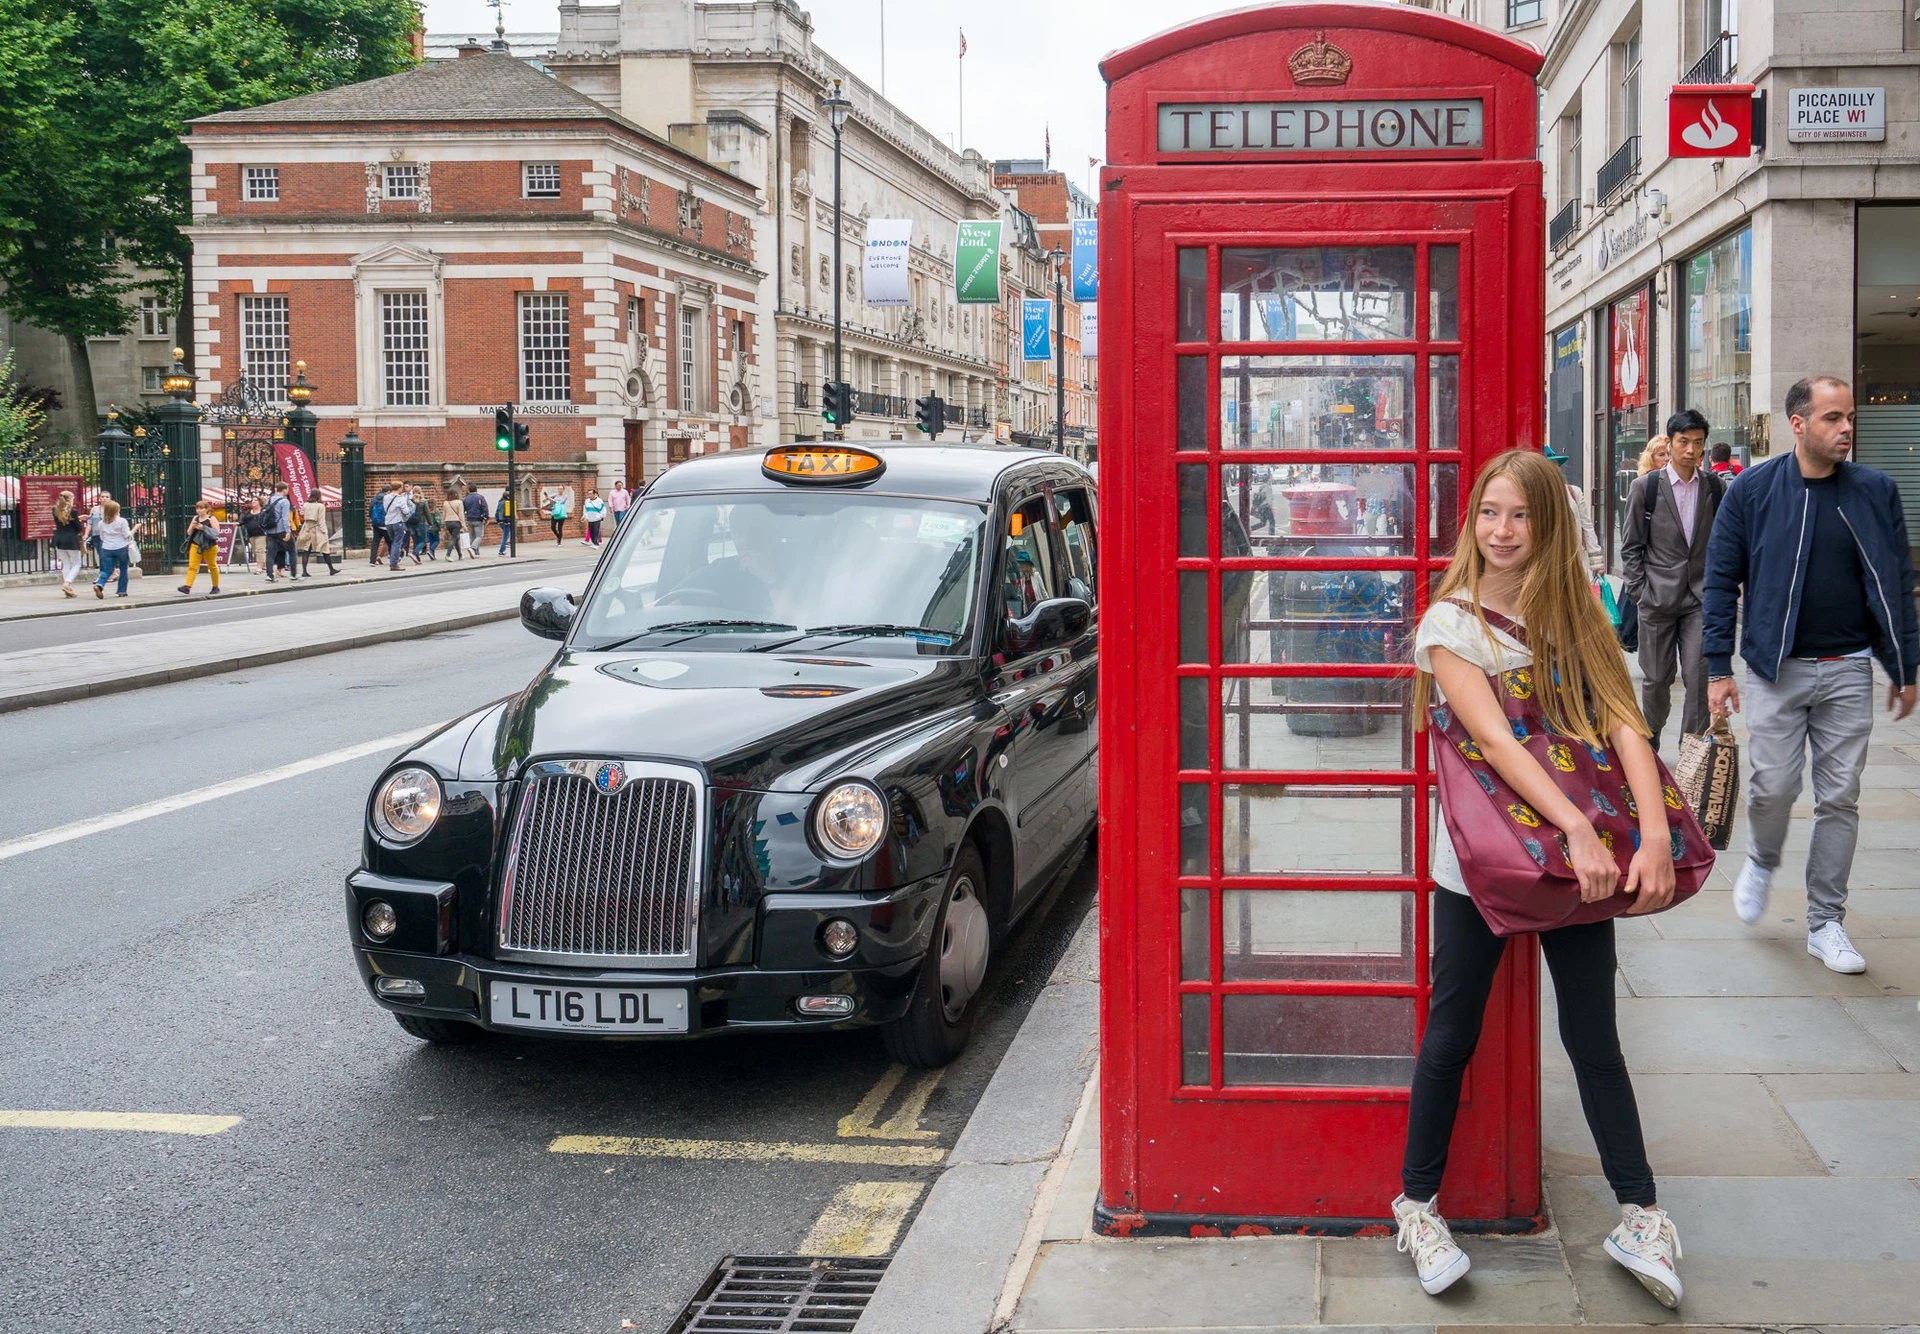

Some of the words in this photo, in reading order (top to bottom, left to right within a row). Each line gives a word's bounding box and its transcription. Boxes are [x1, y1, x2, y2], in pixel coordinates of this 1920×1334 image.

[1798, 93, 1876, 107] PICCADILLY
[1798, 110, 1840, 124] PLACE
[1847, 109, 1866, 123] W1
[1169, 108, 1471, 149] TELEPHONE
[962, 229, 991, 238] West
[1077, 227, 1096, 237] We
[866, 240, 908, 248] LONDON
[960, 237, 988, 247] End.
[1025, 305, 1045, 313] West
[479, 406, 519, 415] MAIN
[522, 405, 580, 415] ASSOULINE
[293, 448, 306, 474] Church
[783, 453, 852, 472] TAXI
[285, 456, 298, 481] Market
[1705, 747, 1731, 825] REWARDS
[512, 987, 584, 1022] LT16
[595, 992, 664, 1023] LDL
